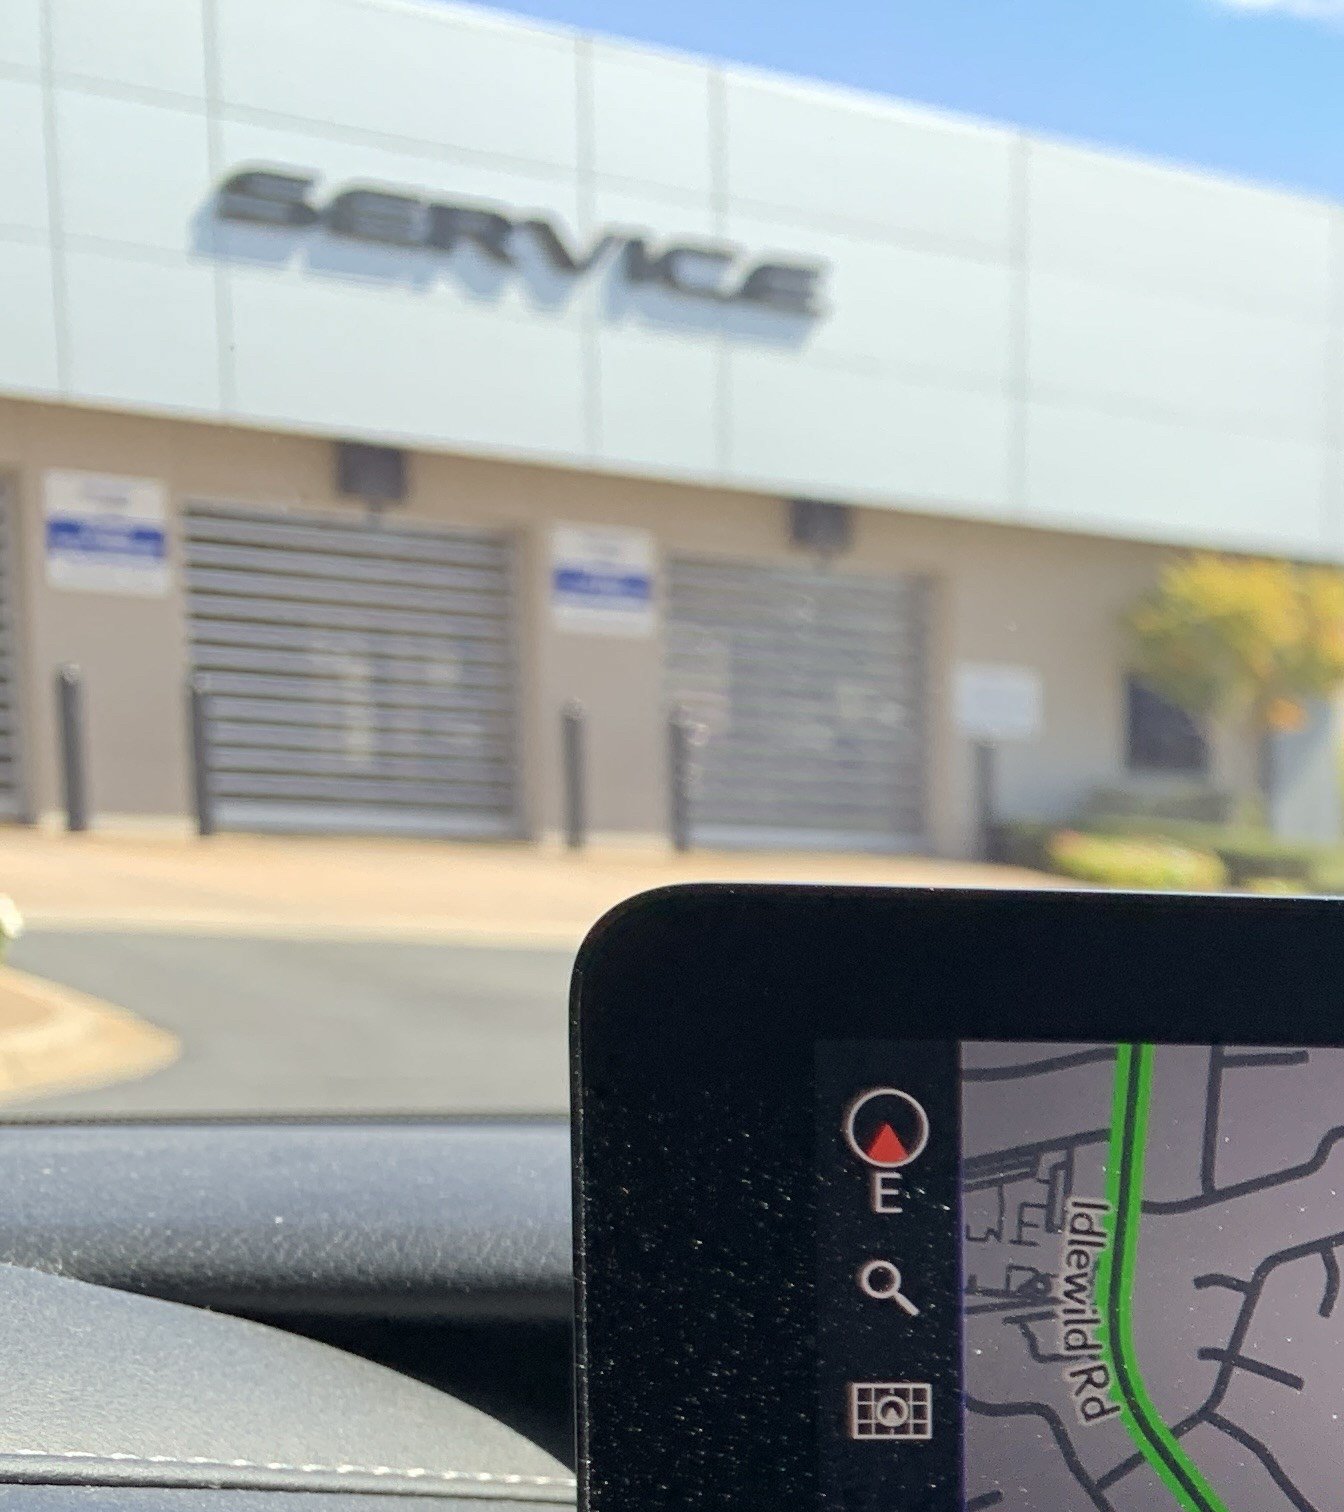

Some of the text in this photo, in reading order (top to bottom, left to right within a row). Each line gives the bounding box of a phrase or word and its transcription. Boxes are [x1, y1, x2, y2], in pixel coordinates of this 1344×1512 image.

[212, 168, 828, 320] SERVICE
[873, 1173, 903, 1214] E
[1062, 1200, 1121, 1423] Idlewild Rd
